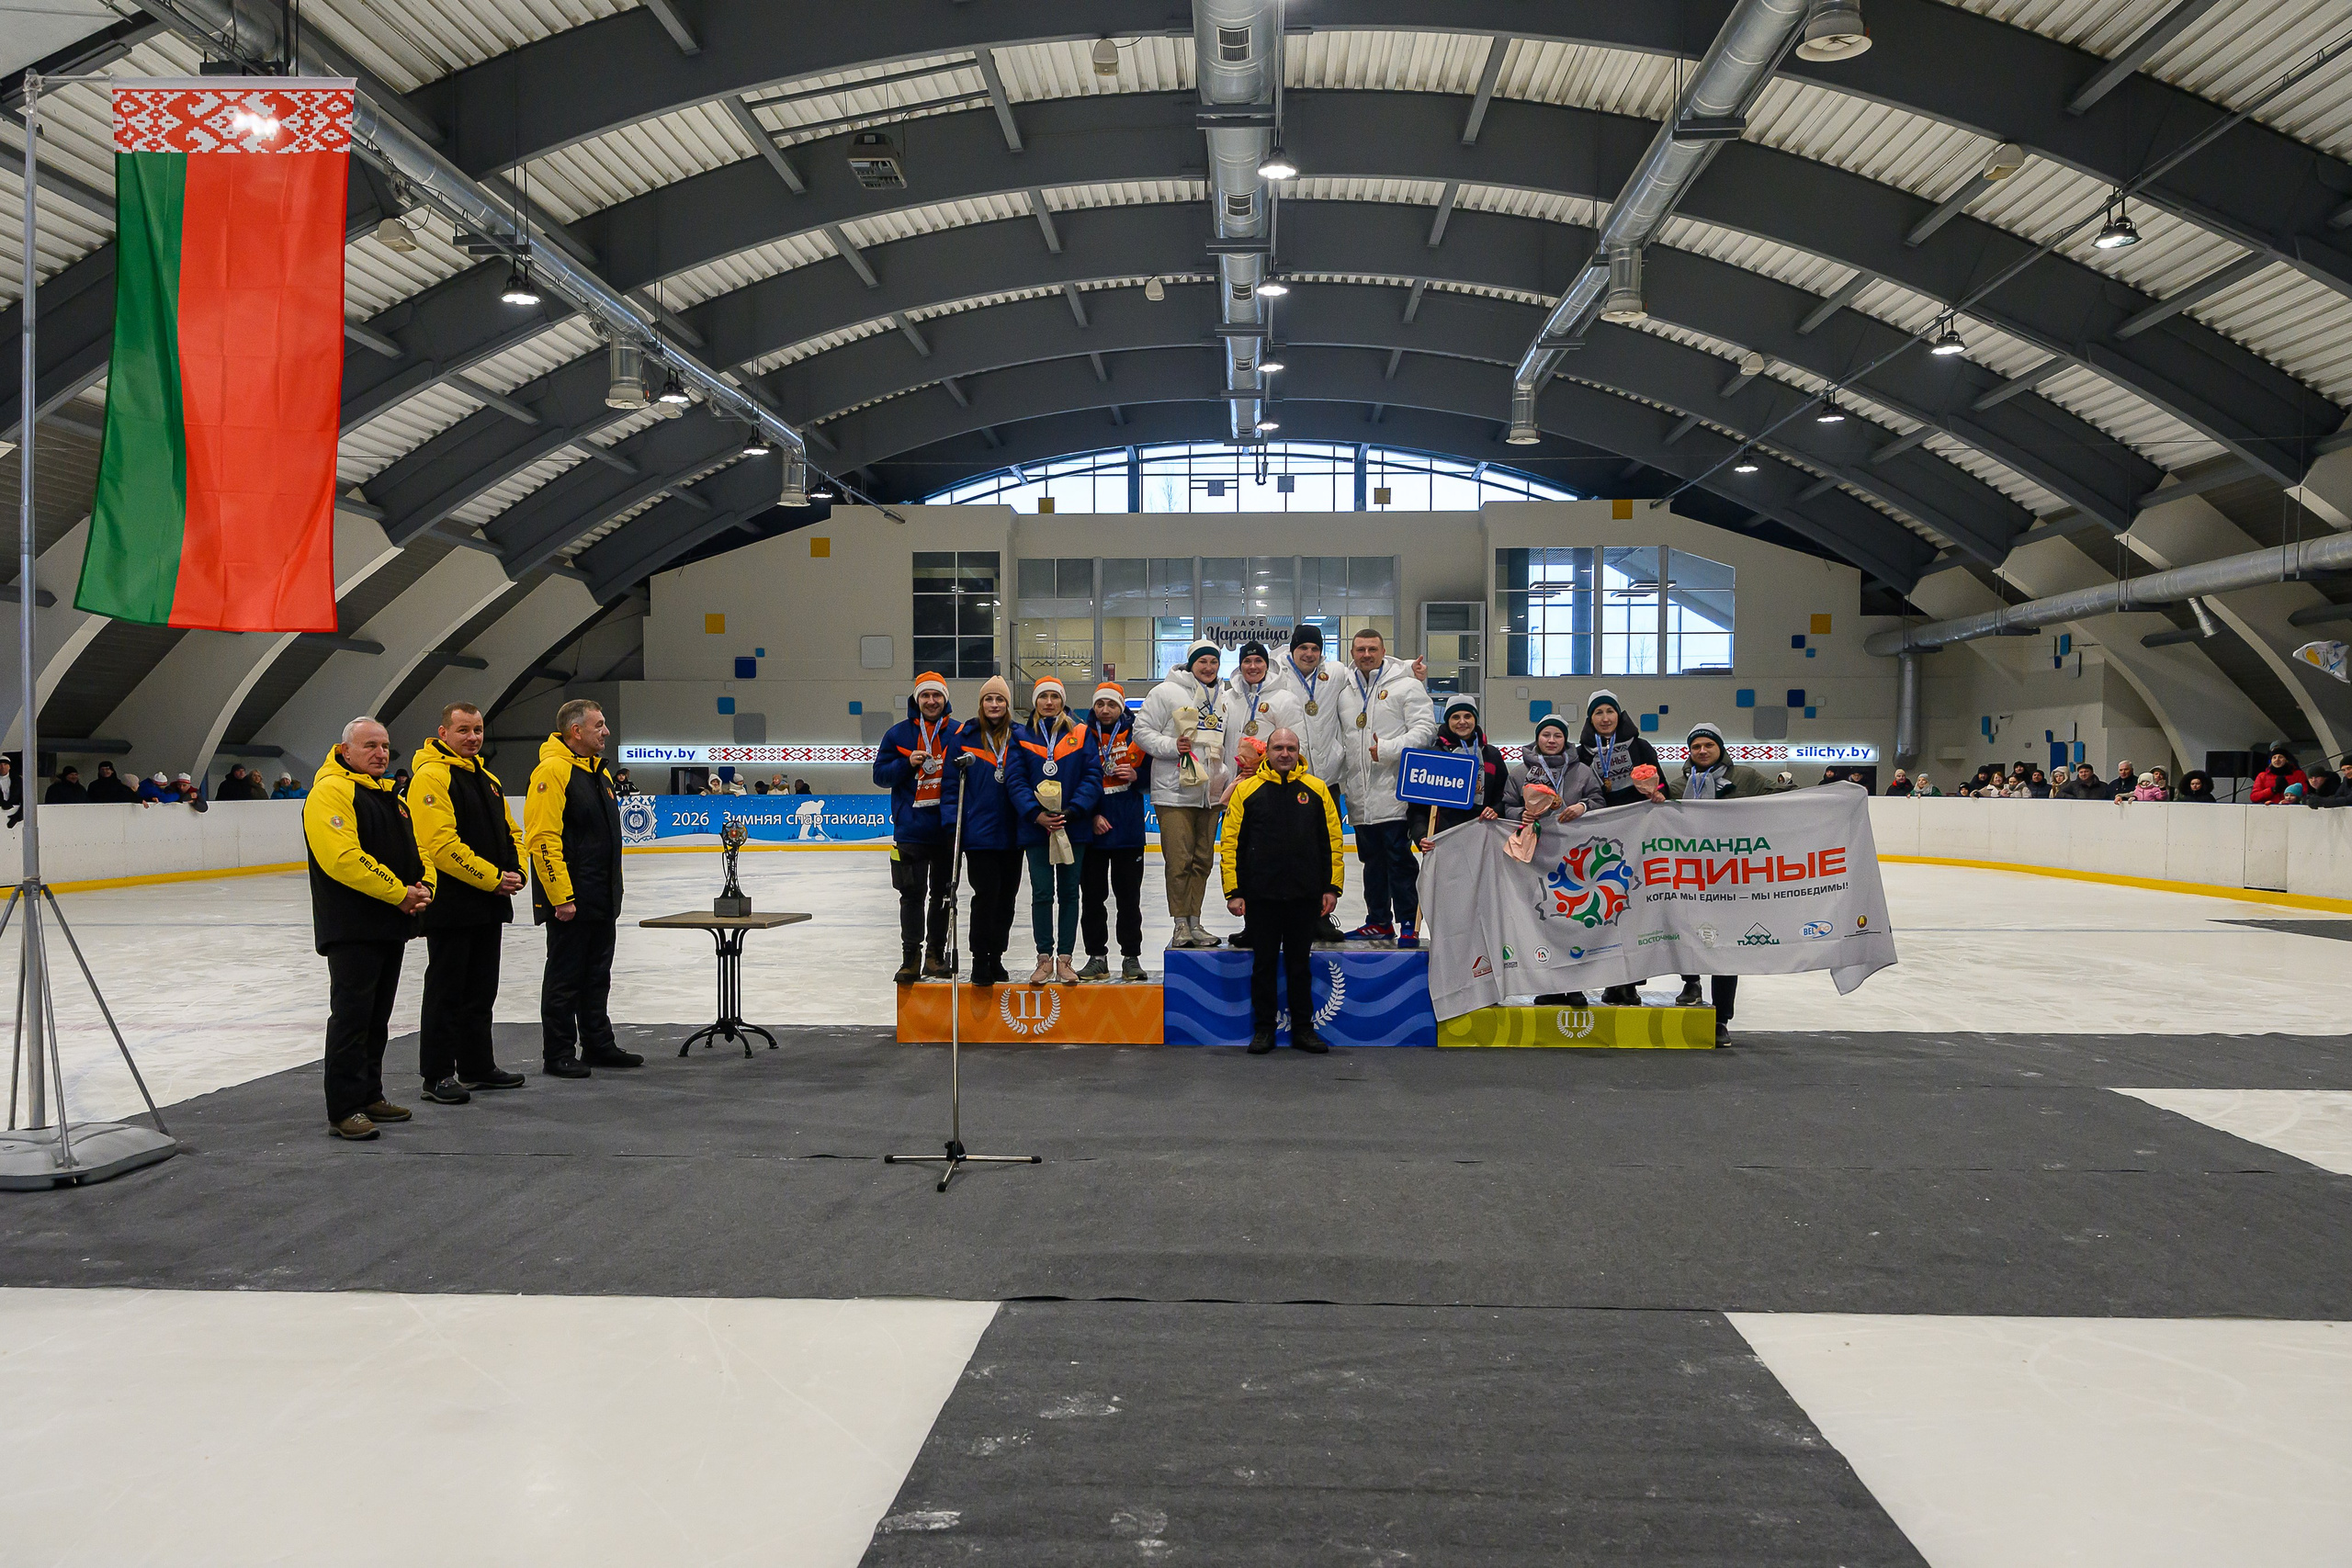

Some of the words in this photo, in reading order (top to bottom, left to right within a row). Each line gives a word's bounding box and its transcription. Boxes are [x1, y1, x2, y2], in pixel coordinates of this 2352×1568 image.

[1232, 619, 1264, 627] КАФЕ
[626, 748, 696, 761] silichy.by
[1796, 746, 1871, 759] silichy.by
[1409, 768, 1464, 789] Единые
[672, 812, 709, 826] 2026
[786, 814, 885, 828] спартакиада
[1642, 837, 1771, 855] КОМАНДА
[358, 855, 394, 886] BELARUS
[450, 852, 485, 880] BELARUS
[540, 843, 557, 883] BELARUS
[1643, 847, 1847, 891] ЕДИНЫЕ
[1646, 892, 1678, 903] КОГДА
[1680, 893, 1697, 901] МЫ
[1700, 894, 1736, 902] ЕДИНЫ
[1751, 893, 1770, 901] МЫ
[1773, 882, 1849, 899] НЕПОБЕДИМЫ!
[1638, 933, 1680, 946] ВОСТОЧНЫЙ
[1015, 990, 1045, 1020] II
[1563, 1010, 1589, 1028] III
